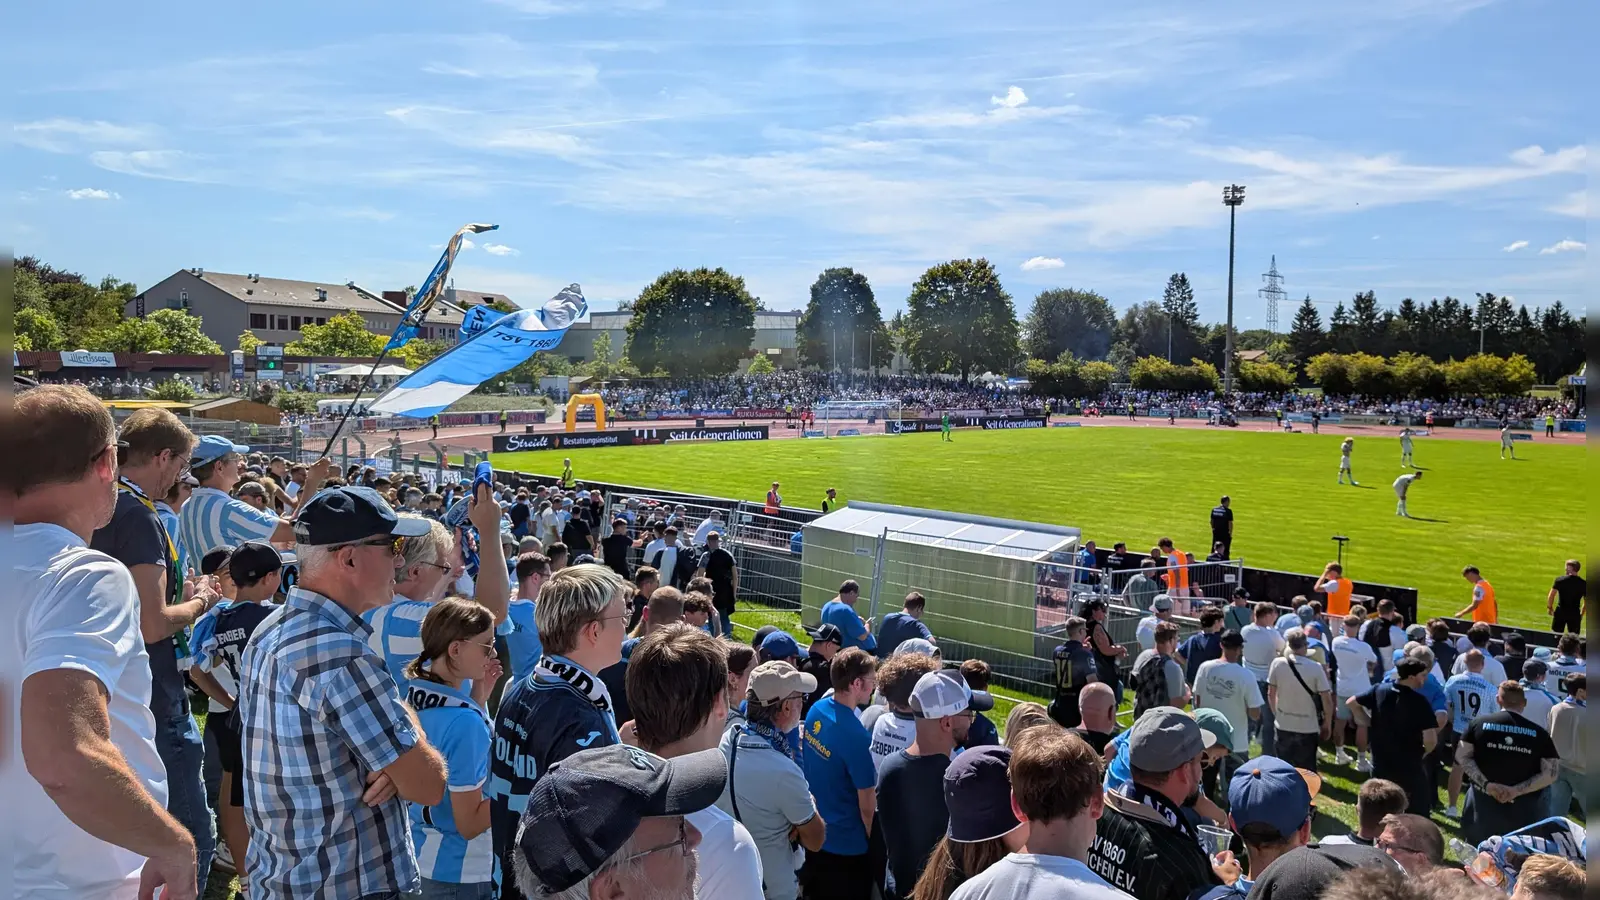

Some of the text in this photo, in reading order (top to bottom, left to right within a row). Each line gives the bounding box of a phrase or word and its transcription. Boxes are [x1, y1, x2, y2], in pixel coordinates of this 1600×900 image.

[493, 331, 523, 344] TSV
[892, 420, 917, 432] Streidt
[985, 419, 998, 429] Seit
[1003, 418, 1043, 429] Generationen
[669, 431, 690, 441] Seit
[690, 430, 697, 440] 6
[699, 429, 762, 441] Generationen
[506, 434, 548, 451] Streidt
[563, 435, 618, 446] Bestattungsinstitut
[1457, 690, 1481, 717] 19
[1482, 722, 1537, 738] FANBETREUUNG
[1498, 743, 1532, 755] Bayerische
[1103, 839, 1126, 865] 1860
[1115, 868, 1136, 893] E.V.
